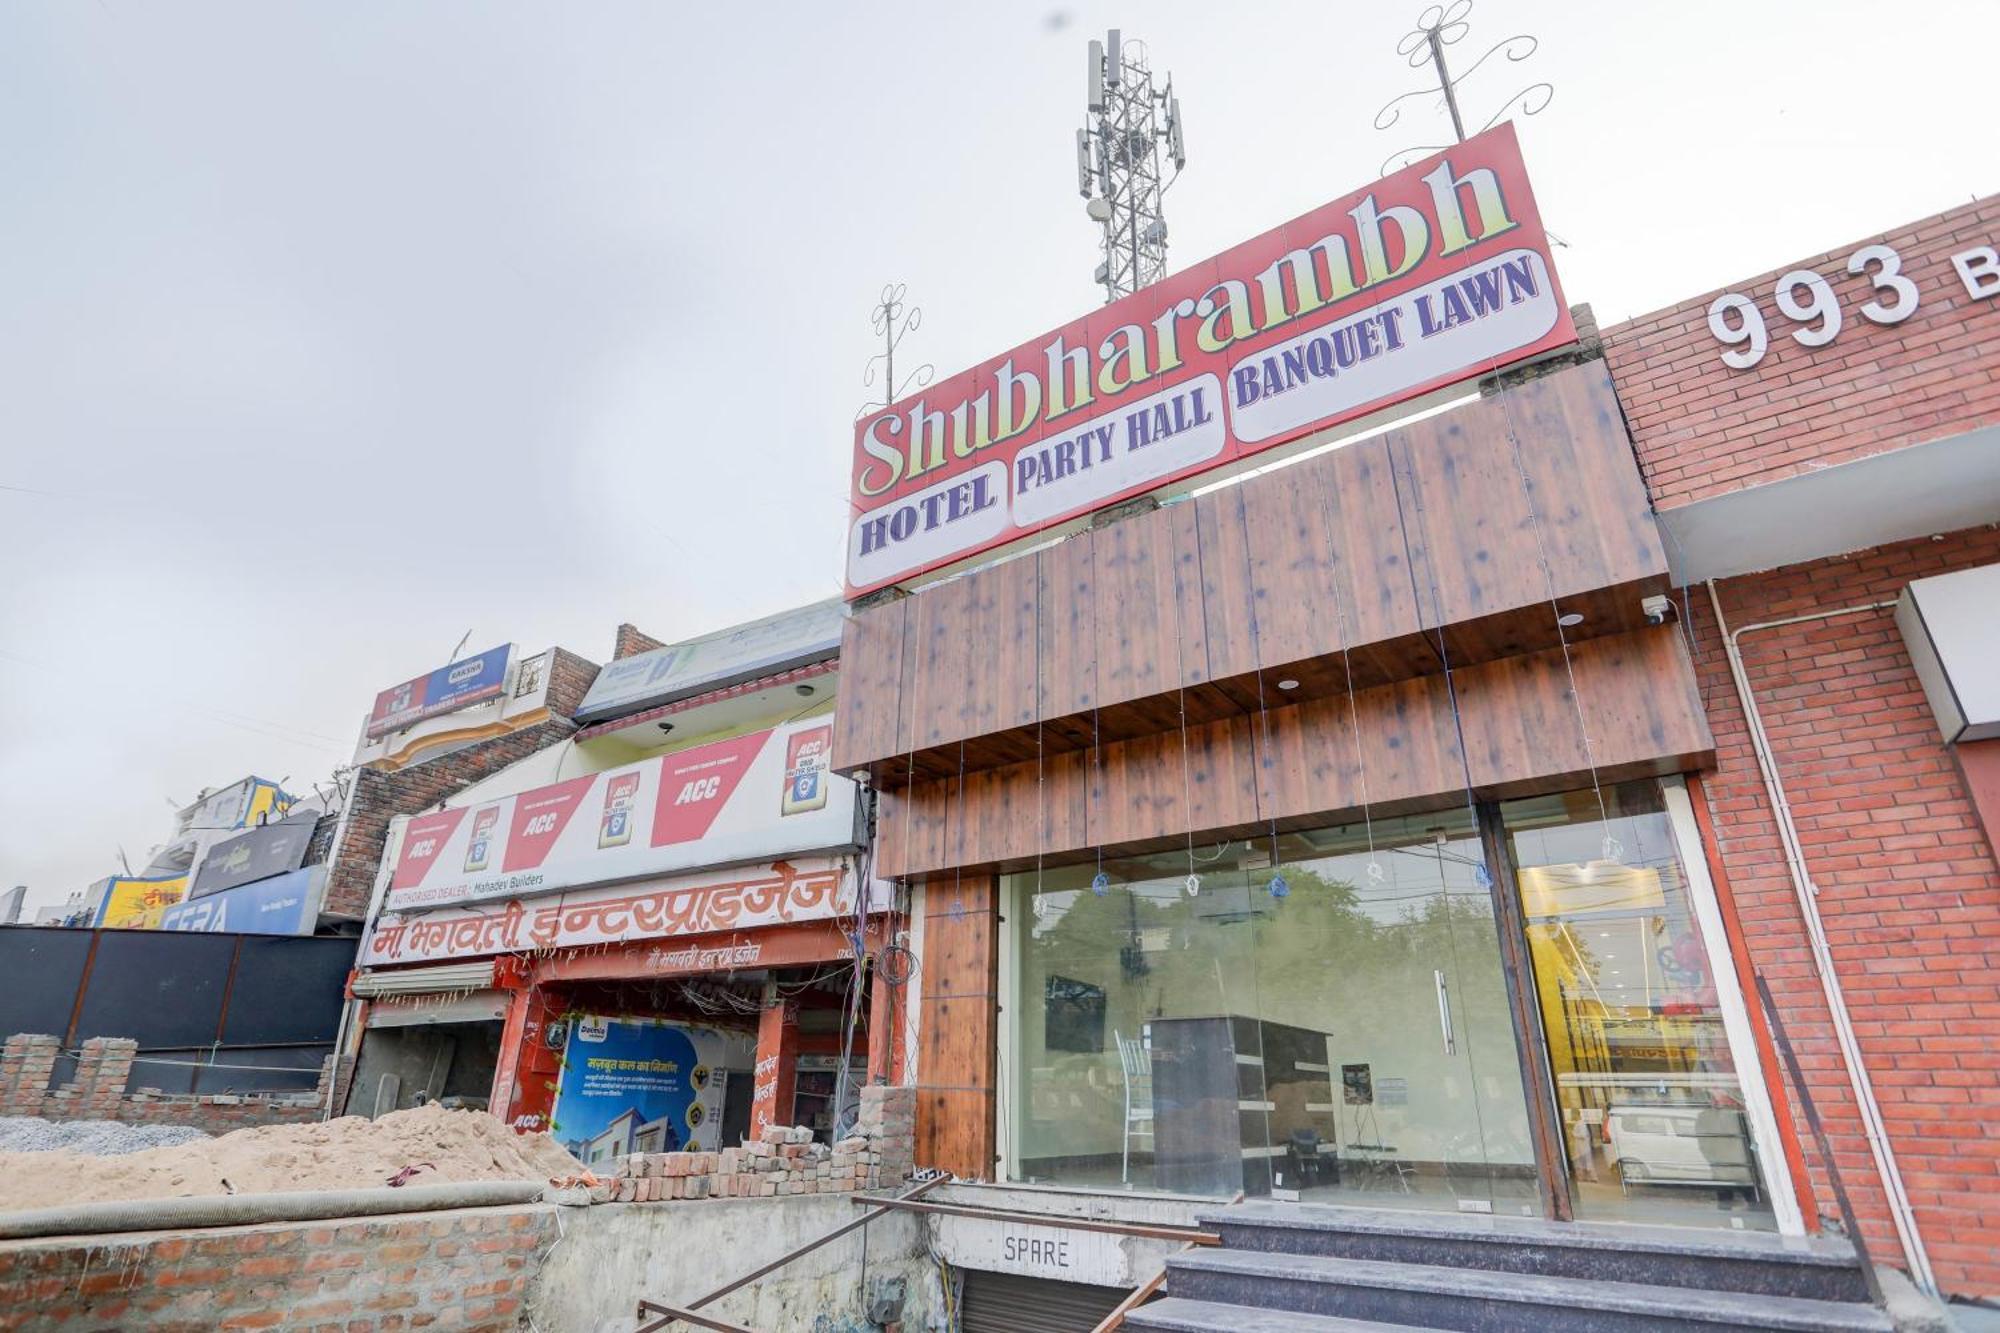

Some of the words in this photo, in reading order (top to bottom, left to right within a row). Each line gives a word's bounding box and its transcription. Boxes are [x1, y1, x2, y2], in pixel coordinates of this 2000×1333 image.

[1707, 244, 1920, 370] 993
[858, 159, 1520, 497] Shubharambh
[1233, 305, 1406, 409] BANQUET
[1414, 255, 1540, 339] LAWN
[1016, 422, 1117, 494] PARTY
[1126, 386, 1213, 452] HALL
[860, 471, 998, 556] HOTEL
[674, 776, 721, 806] ACC
[523, 813, 557, 837] ACC
[408, 839, 437, 860] ACC
[473, 879, 509, 894] Mahadev
[509, 873, 544, 889] Builders
[410, 900, 526, 956] भगवती
[660, 943, 699, 969] भगवती
[514, 1114, 540, 1128] ACC
[1005, 1236, 1070, 1268] SPARE
